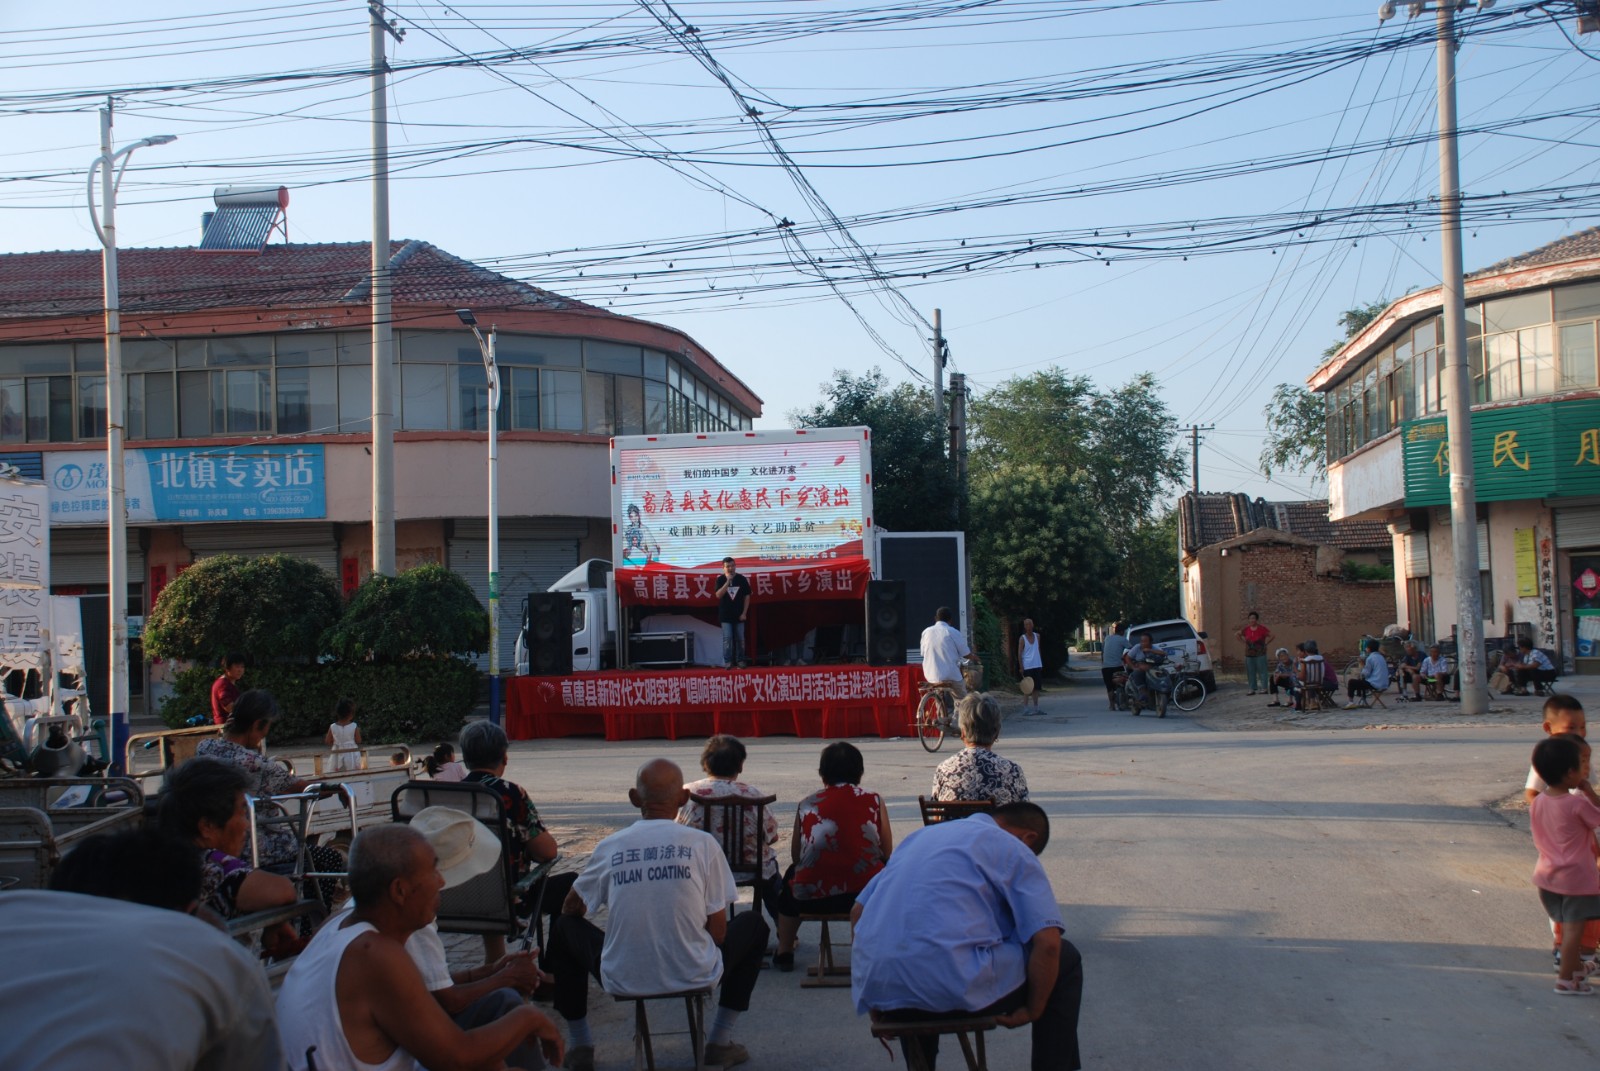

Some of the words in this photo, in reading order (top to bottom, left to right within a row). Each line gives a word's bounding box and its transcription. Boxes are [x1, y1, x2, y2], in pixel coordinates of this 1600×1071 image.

[157, 449, 313, 488] 北镇专卖店
[683, 467, 740, 479] 我们的中国梦
[749, 465, 797, 476] 文化进万家
[641, 484, 849, 514] 高唐县文化惠民下乡演出
[631, 569, 853, 600] 高唐县文民下乡演出
[560, 670, 900, 707] 高唐县新时代文明实践“唱响新时代”文化演出月活动走进梁村镇
[613, 869, 643, 886] YULAN
[647, 865, 692, 881] COATING
